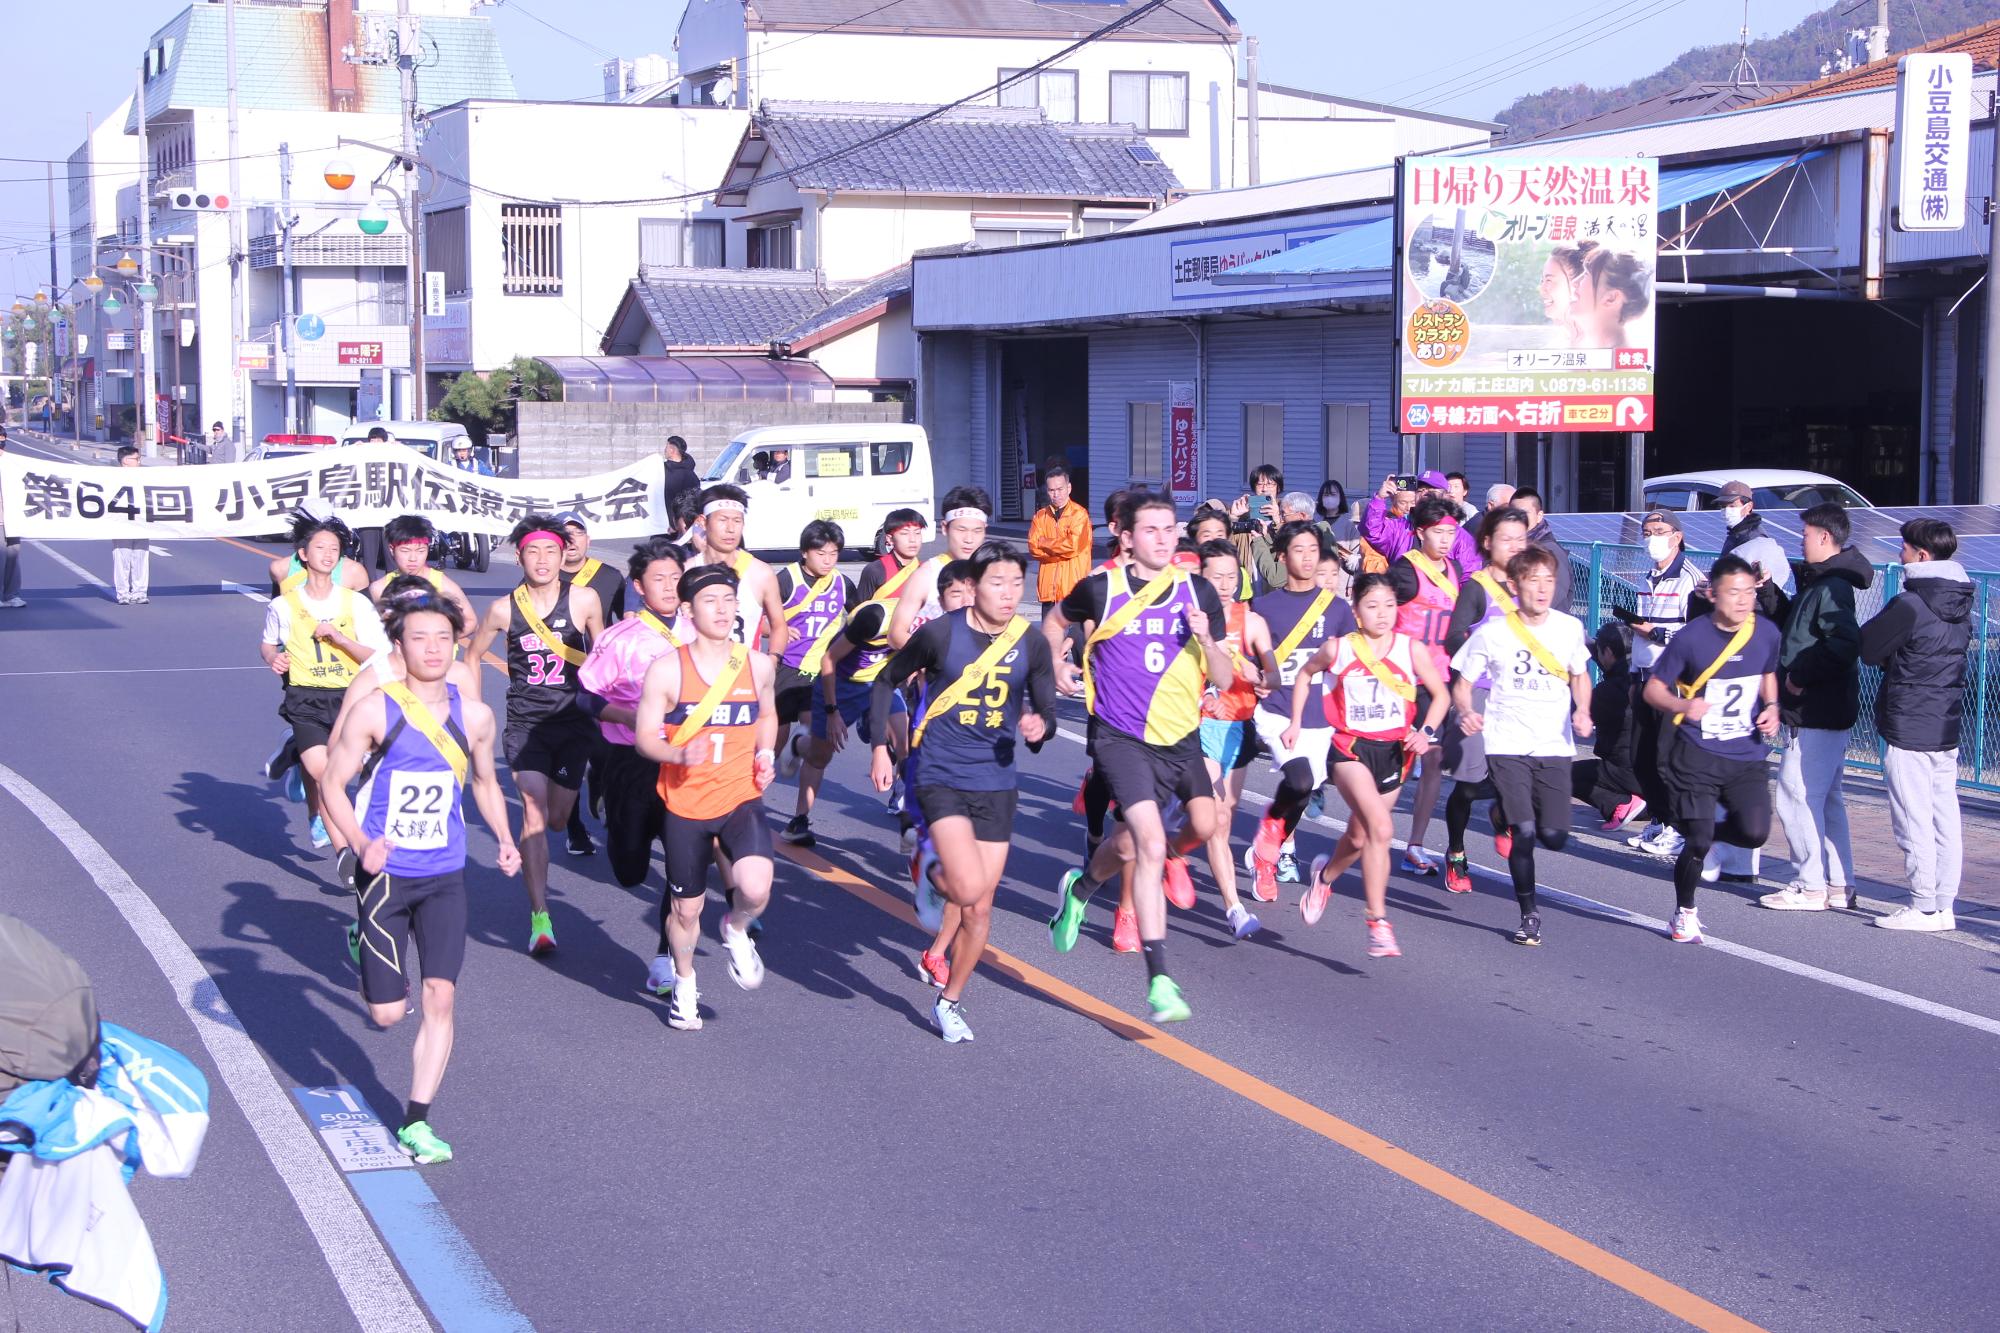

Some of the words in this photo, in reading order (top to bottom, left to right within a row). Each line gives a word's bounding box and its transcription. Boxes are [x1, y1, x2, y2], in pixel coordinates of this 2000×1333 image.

[1413, 165, 1650, 206] 日帰り天然温泉
[1413, 313, 1465, 327] レストラン
[1414, 329, 1463, 342] カラオケ
[1416, 343, 1446, 360] あり
[1618, 352, 1645, 366] 検索
[1406, 378, 1534, 392] マルナカ新土庄店内
[1549, 377, 1647, 392] 0879-61-1136
[1409, 408, 1427, 422] 254
[1432, 401, 1561, 425] 号線方面へ右折
[1568, 407, 1609, 419] 車で2分
[1174, 418, 1189, 483] ゆうパック
[22, 471, 194, 523] 第64回
[215, 461, 650, 523] 小豆島駅伝競走大会
[805, 616, 829, 638] 17
[1144, 641, 1166, 673] 6
[527, 653, 566, 686] 32
[1367, 678, 1379, 702] 7
[1723, 684, 1743, 717] 2
[959, 710, 1004, 729] 四海
[709, 733, 725, 764] 1
[400, 784, 442, 814] 22
[320, 1112, 369, 1122] 50m
